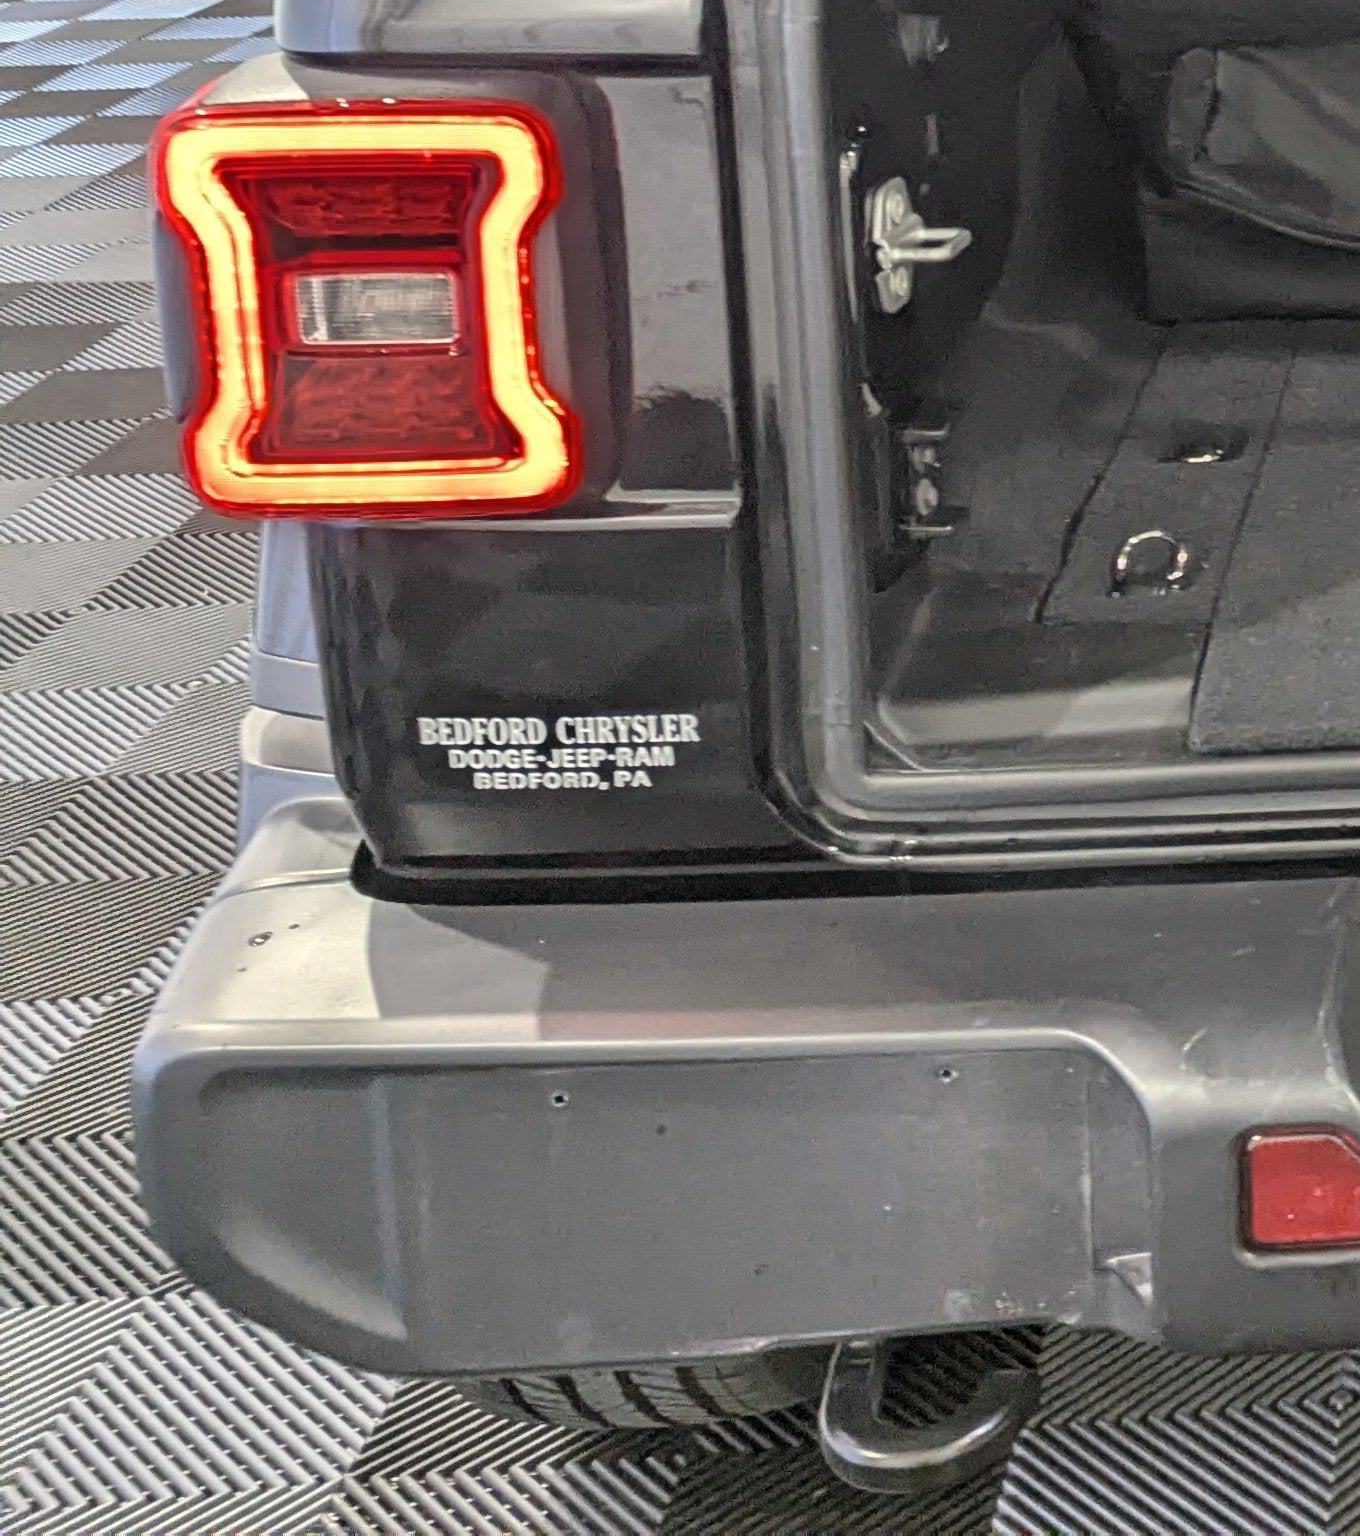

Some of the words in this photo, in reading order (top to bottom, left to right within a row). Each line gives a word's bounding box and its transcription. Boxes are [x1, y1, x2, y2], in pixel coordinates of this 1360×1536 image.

[417, 717, 547, 745] BEDFORD
[555, 713, 701, 744] CHRYSLER
[473, 772, 610, 790] BEDFORD,
[613, 770, 653, 788] PA
